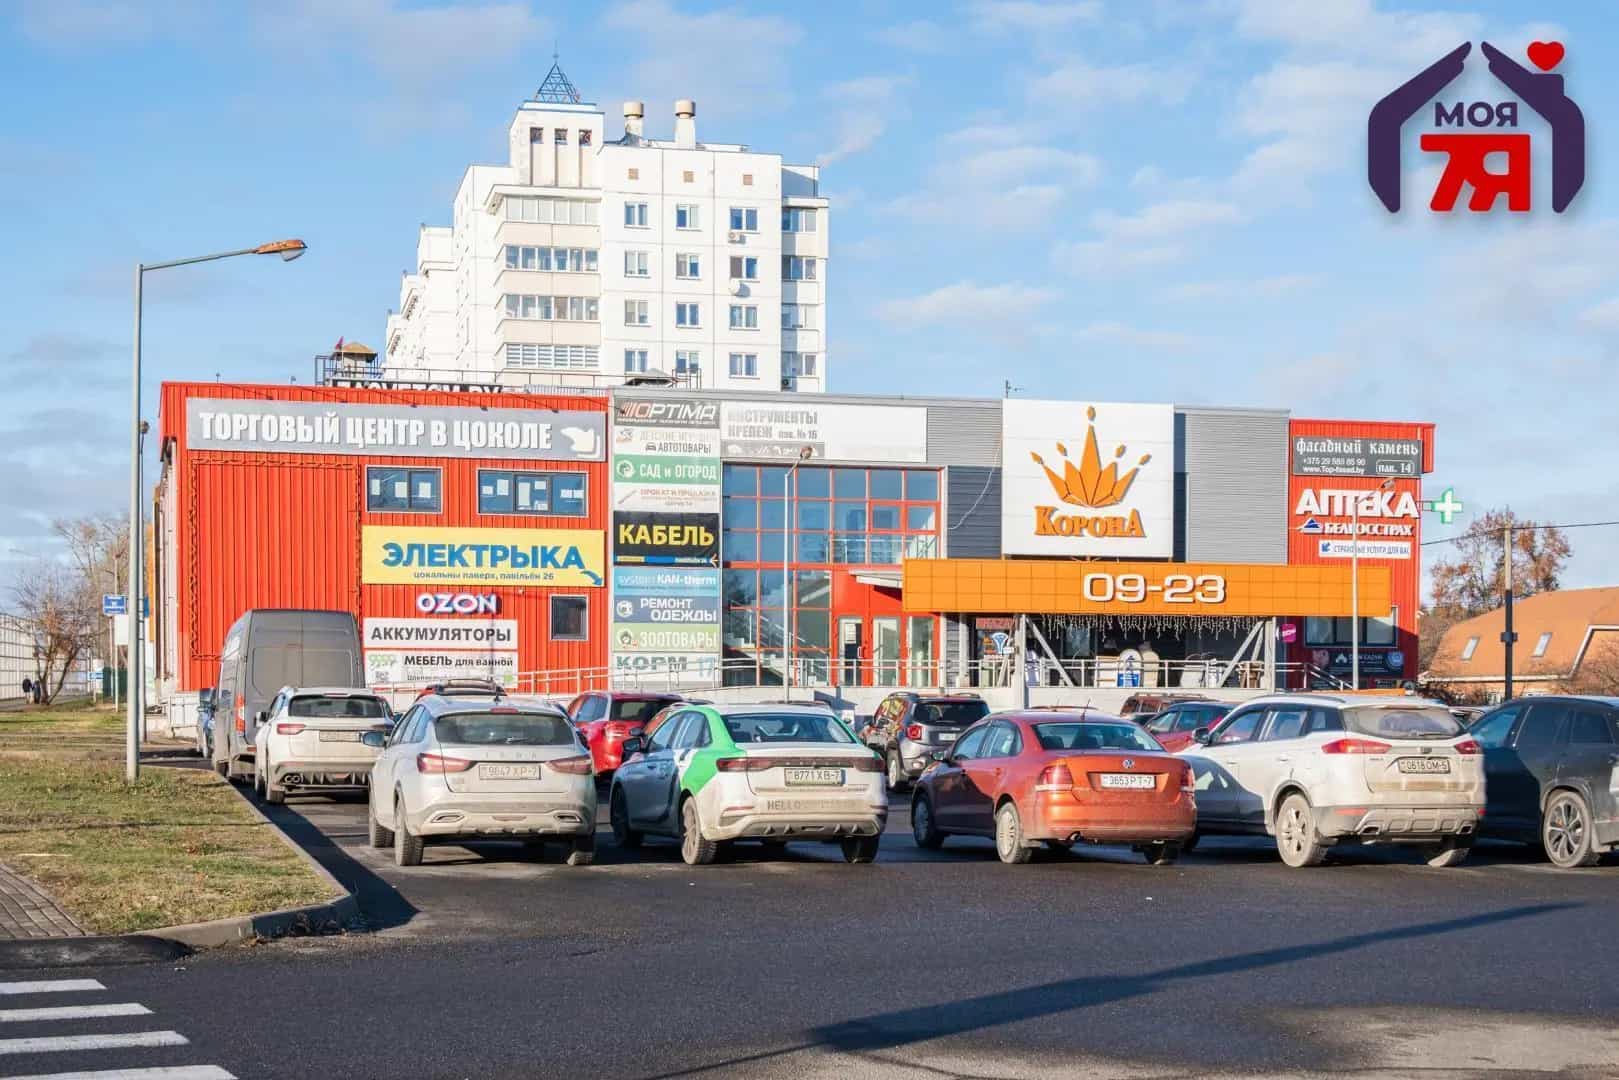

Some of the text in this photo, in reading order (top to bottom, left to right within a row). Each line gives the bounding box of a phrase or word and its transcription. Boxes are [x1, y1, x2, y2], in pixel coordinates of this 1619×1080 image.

[637, 402, 716, 420] OPTIMA
[199, 411, 552, 452] ТОРГОВЫЙ ЦЕНТР В ЦОКОЛЕ
[657, 442, 711, 453] АВТОТОВАРЫ
[640, 464, 661, 479] САД
[675, 464, 717, 480] ОГОРОД
[1295, 488, 1419, 518] АПТЕКА
[619, 524, 714, 546] КАБЕЛЬ
[382, 542, 586, 569] ЭЛЕКТРЫКА
[1083, 573, 1227, 604] 09-23
[416, 592, 499, 614] OZON
[640, 598, 693, 608] РЕМОНТ
[650, 609, 717, 622] ОДЕЖДЫ
[371, 627, 511, 642] АККУМУЛЯТОРЫ
[640, 631, 717, 648] ЗООТОВАРЫ
[404, 655, 452, 666] МЕБЕЛЬ
